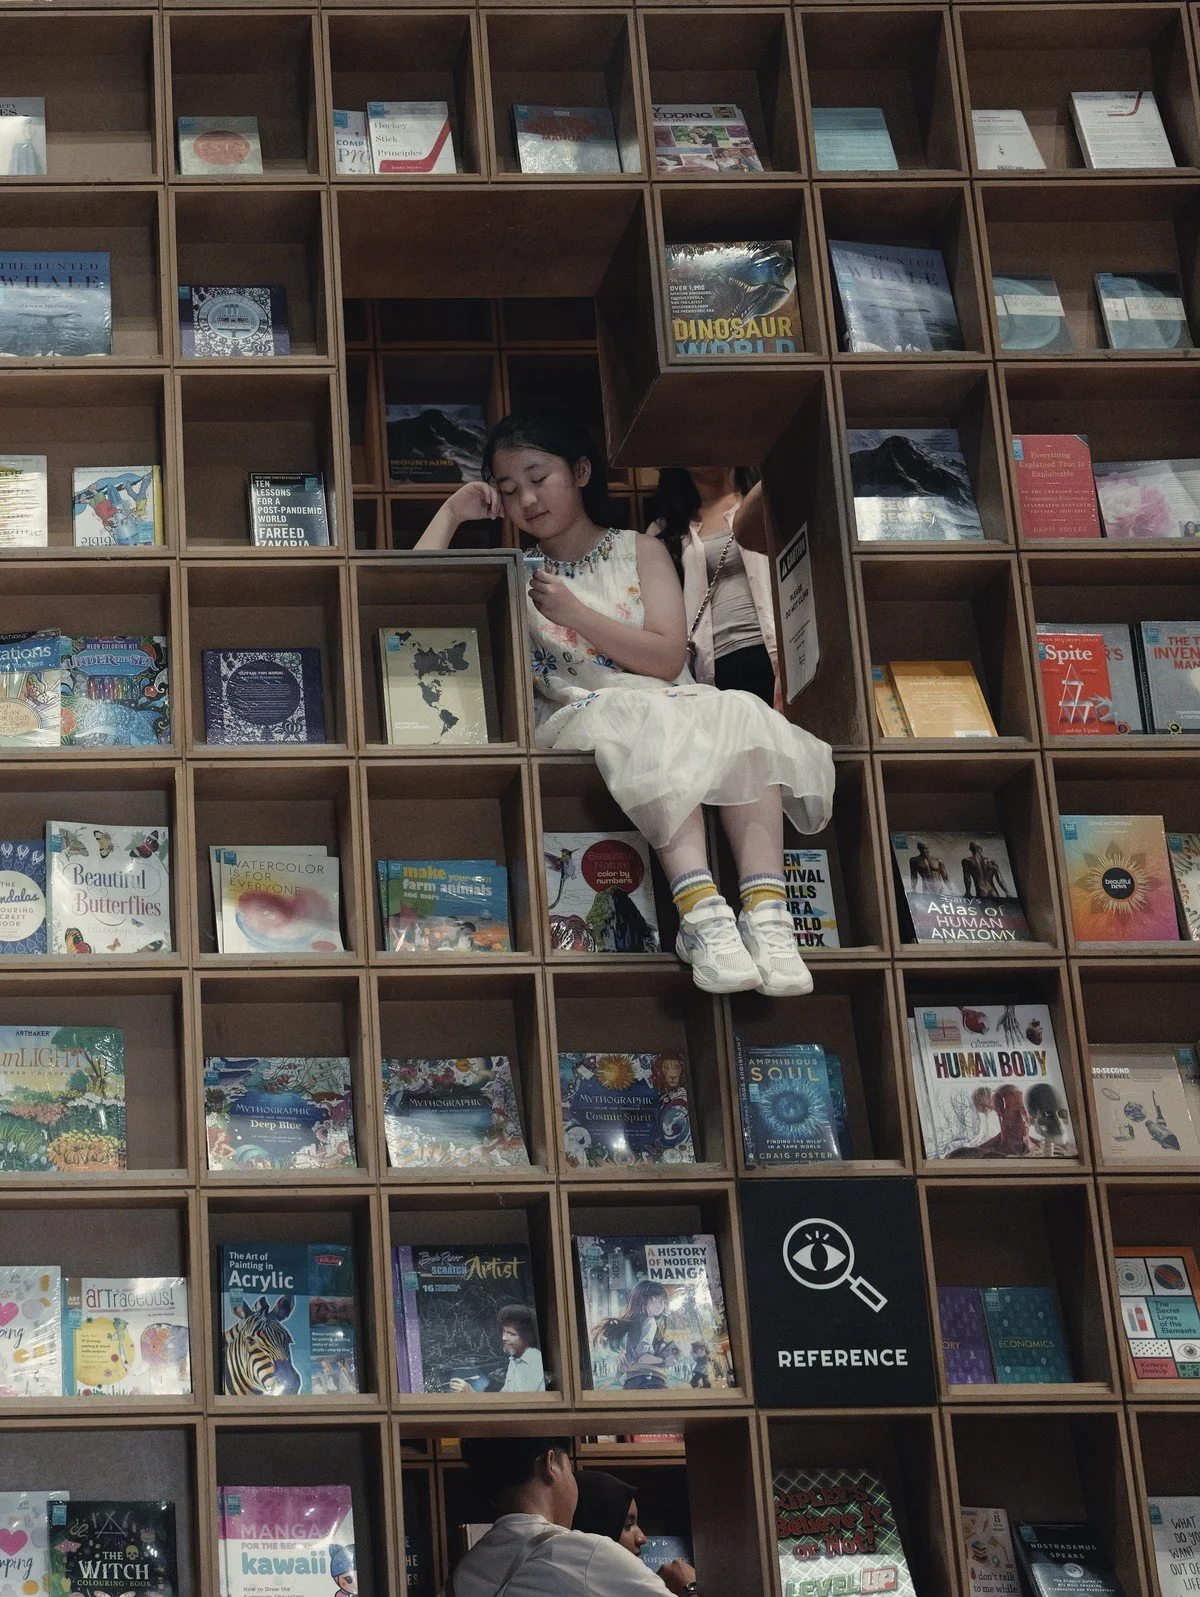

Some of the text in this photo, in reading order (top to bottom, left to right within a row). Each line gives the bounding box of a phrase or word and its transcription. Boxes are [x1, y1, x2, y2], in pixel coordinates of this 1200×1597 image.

[374, 121, 407, 129] Hockey
[378, 149, 423, 157] Principles
[0, 275, 99, 288] WHALE
[674, 316, 793, 341] DINOSAUR
[255, 480, 270, 488] TEN
[258, 515, 287, 523] WORLD
[259, 528, 304, 538] FAREED
[1167, 636, 1191, 646] THE
[1045, 644, 1093, 665] Spite
[233, 860, 325, 874] WATERCOLOR
[230, 868, 272, 881] IS FOR
[596, 877, 632, 885] numbers
[597, 871, 630, 880] color by
[230, 879, 302, 896] EVERYONE
[403, 879, 493, 896] farm animals
[73, 891, 162, 917] Butterflies
[928, 902, 1006, 916] Atlas of
[936, 915, 1003, 928] HUMAN
[931, 928, 1017, 941] ANATOMY
[748, 1058, 818, 1066] AMPHIBIOUS
[933, 1049, 1048, 1079] HUMAN BODY
[751, 1067, 820, 1082] SOUL
[409, 1098, 482, 1108] MYTHOGRAPHIC
[579, 1093, 654, 1105] MYTHOGRAPHIC
[236, 1104, 311, 1116] MYTHOGRAPHIC
[585, 1110, 652, 1123] Cosmic Spirit
[250, 1119, 301, 1131] Deep Blue
[229, 1251, 268, 1261] The Art of
[648, 1247, 707, 1258] A HISTORY
[229, 1260, 274, 1271] Painting in
[431, 1255, 527, 1280] SCRATCH Artist
[648, 1257, 707, 1267] OF MODERN
[228, 1270, 294, 1292] Acrylic
[998, 1340, 1055, 1349] ECONOMICS
[777, 1348, 909, 1368] REFERENCE
[774, 1502, 886, 1540] Believe It
[1171, 1516, 1197, 1530] WHAT
[241, 1523, 323, 1539] MANGA
[792, 1528, 879, 1560] or Not!
[1030, 1543, 1097, 1551] NOSTRADAMUS
[103, 1551, 124, 1560] THE
[1050, 1552, 1085, 1560] SPEAKS
[1169, 1546, 1194, 1559] WANT
[77, 1559, 150, 1580] WITCH
[241, 1551, 328, 1575] kawaii
[978, 1570, 1016, 1581] don't talk
